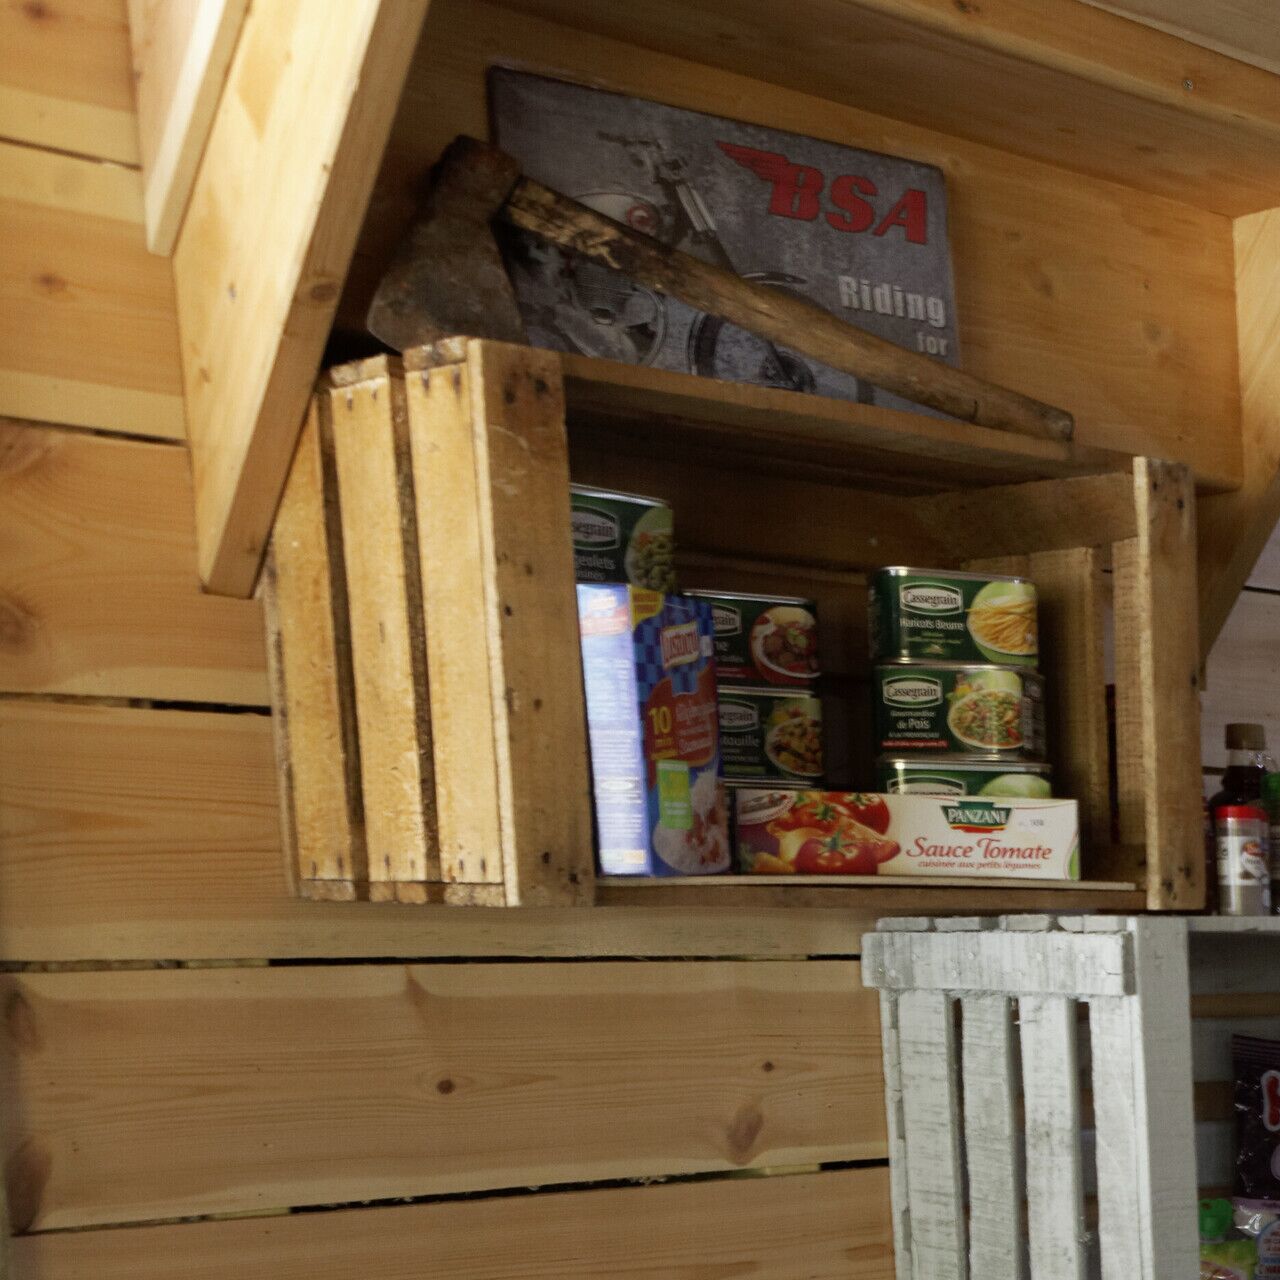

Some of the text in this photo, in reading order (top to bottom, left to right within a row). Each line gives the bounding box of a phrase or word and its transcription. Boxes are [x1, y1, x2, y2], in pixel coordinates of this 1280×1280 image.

[766, 158, 929, 247] BSA
[838, 275, 947, 329] Riding
[917, 331, 948, 357] for
[886, 684, 938, 701] Cassegrain
[648, 706, 673, 735] 10
[948, 807, 1007, 825] PANZANI
[906, 836, 1053, 860] Sauce Tomate
